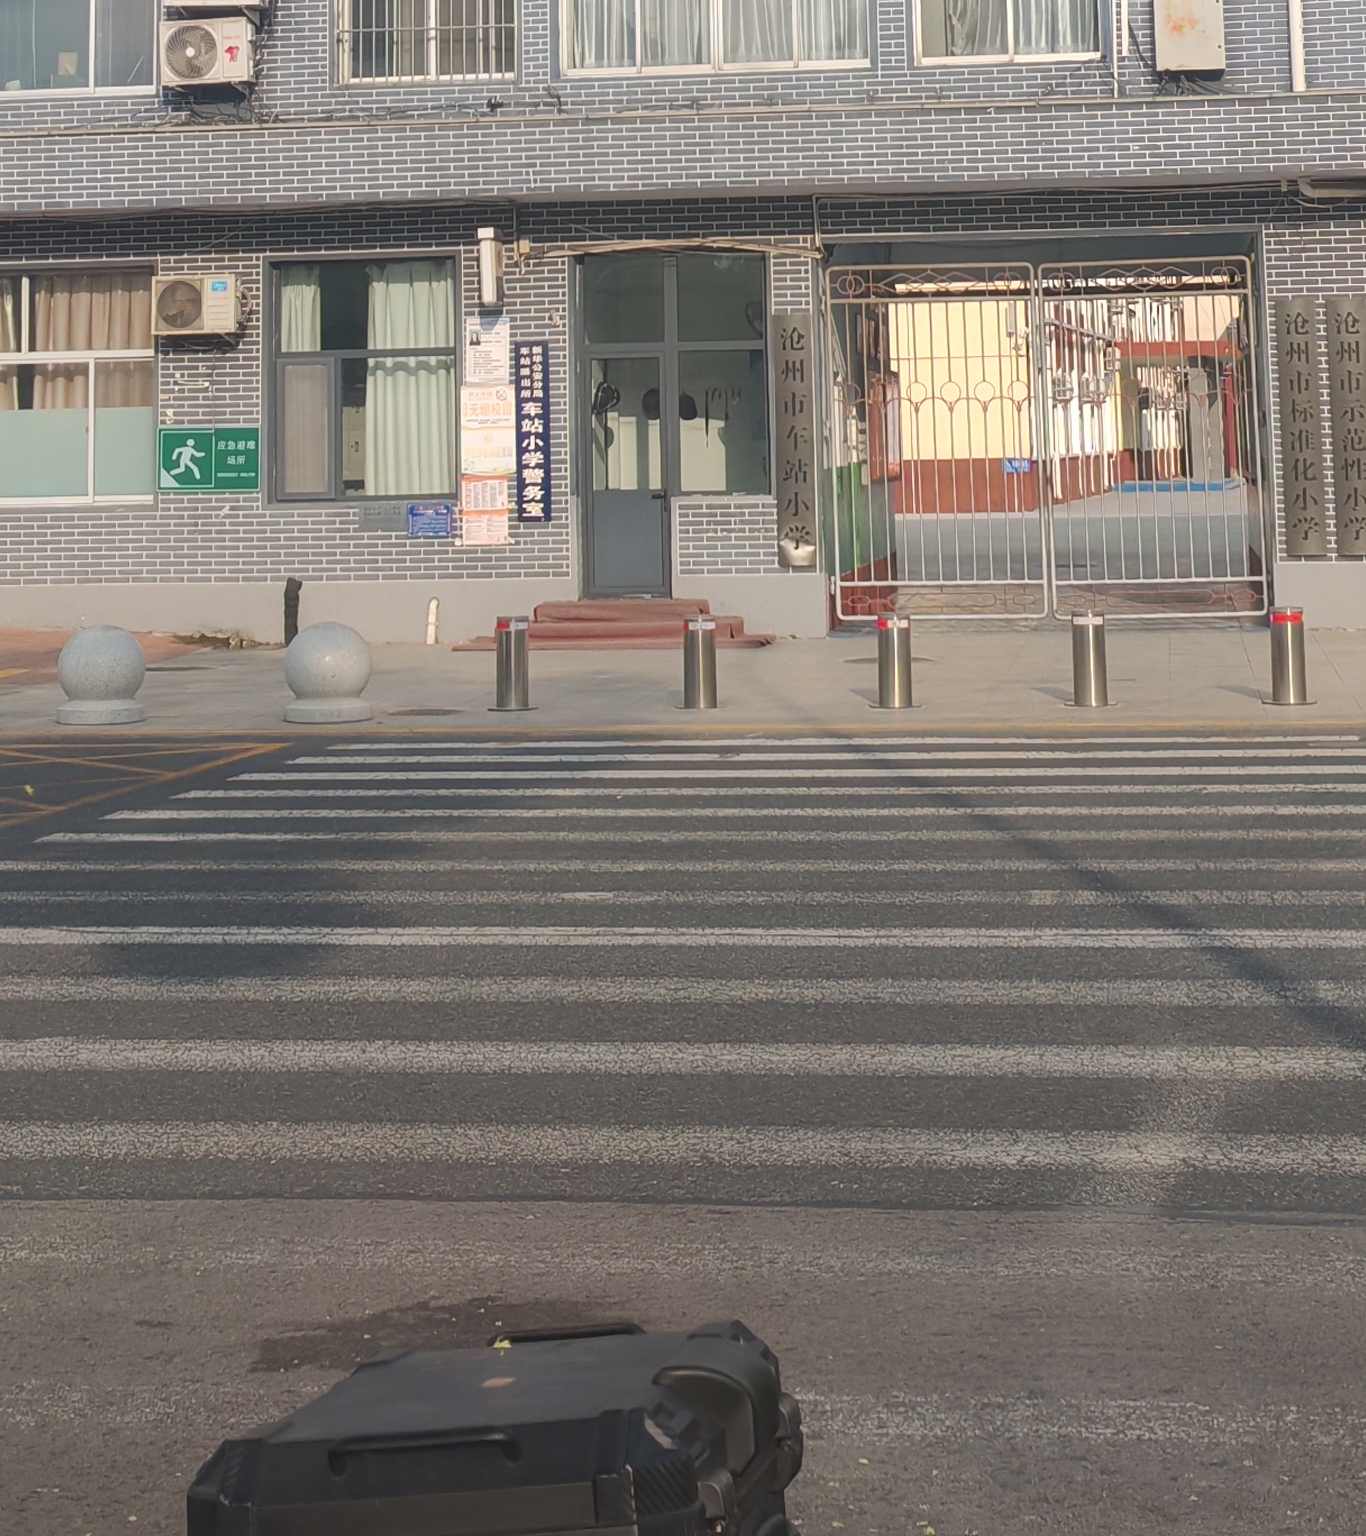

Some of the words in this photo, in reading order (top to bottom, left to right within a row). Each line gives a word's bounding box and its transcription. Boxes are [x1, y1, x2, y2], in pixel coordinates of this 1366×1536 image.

[226, 455, 246, 466] 场所
[520, 401, 545, 518] 车站小学警务室
[781, 327, 811, 551] 沧州市车站小学
[1285, 312, 1321, 541] 沧州市标准化小学
